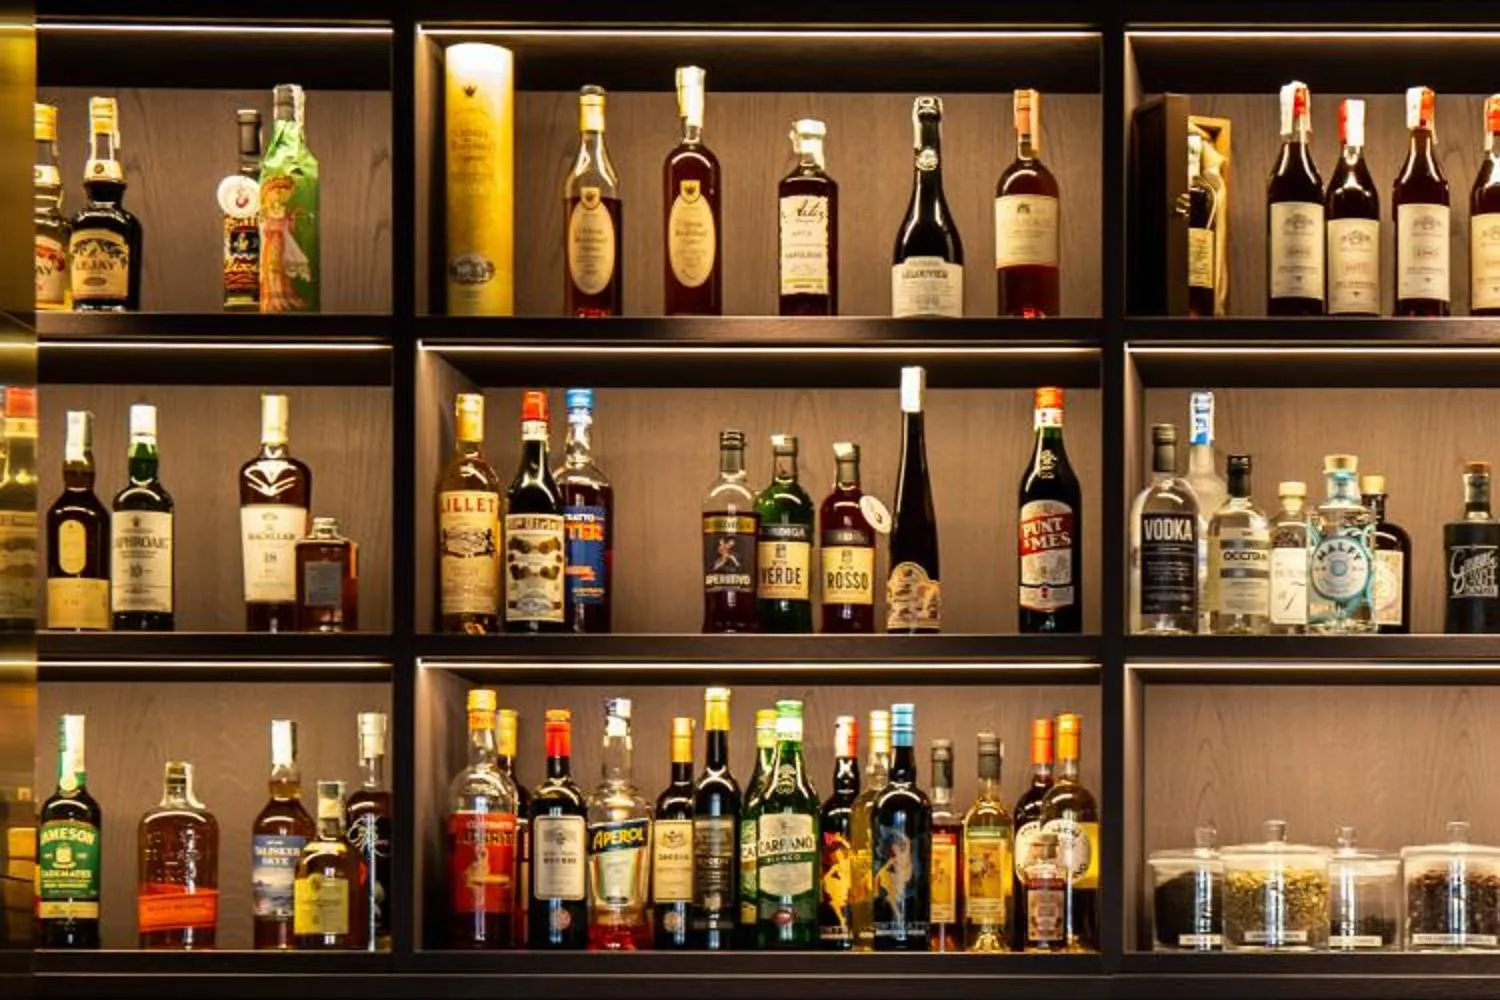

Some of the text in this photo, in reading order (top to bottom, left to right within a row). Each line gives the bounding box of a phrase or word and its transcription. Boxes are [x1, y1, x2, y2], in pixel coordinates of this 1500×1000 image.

[1023, 517, 1063, 536] PUNT
[1143, 517, 1193, 541] VODKA
[760, 567, 802, 586] VERDE
[827, 571, 870, 591] ROSSO
[592, 827, 645, 850] APEROL
